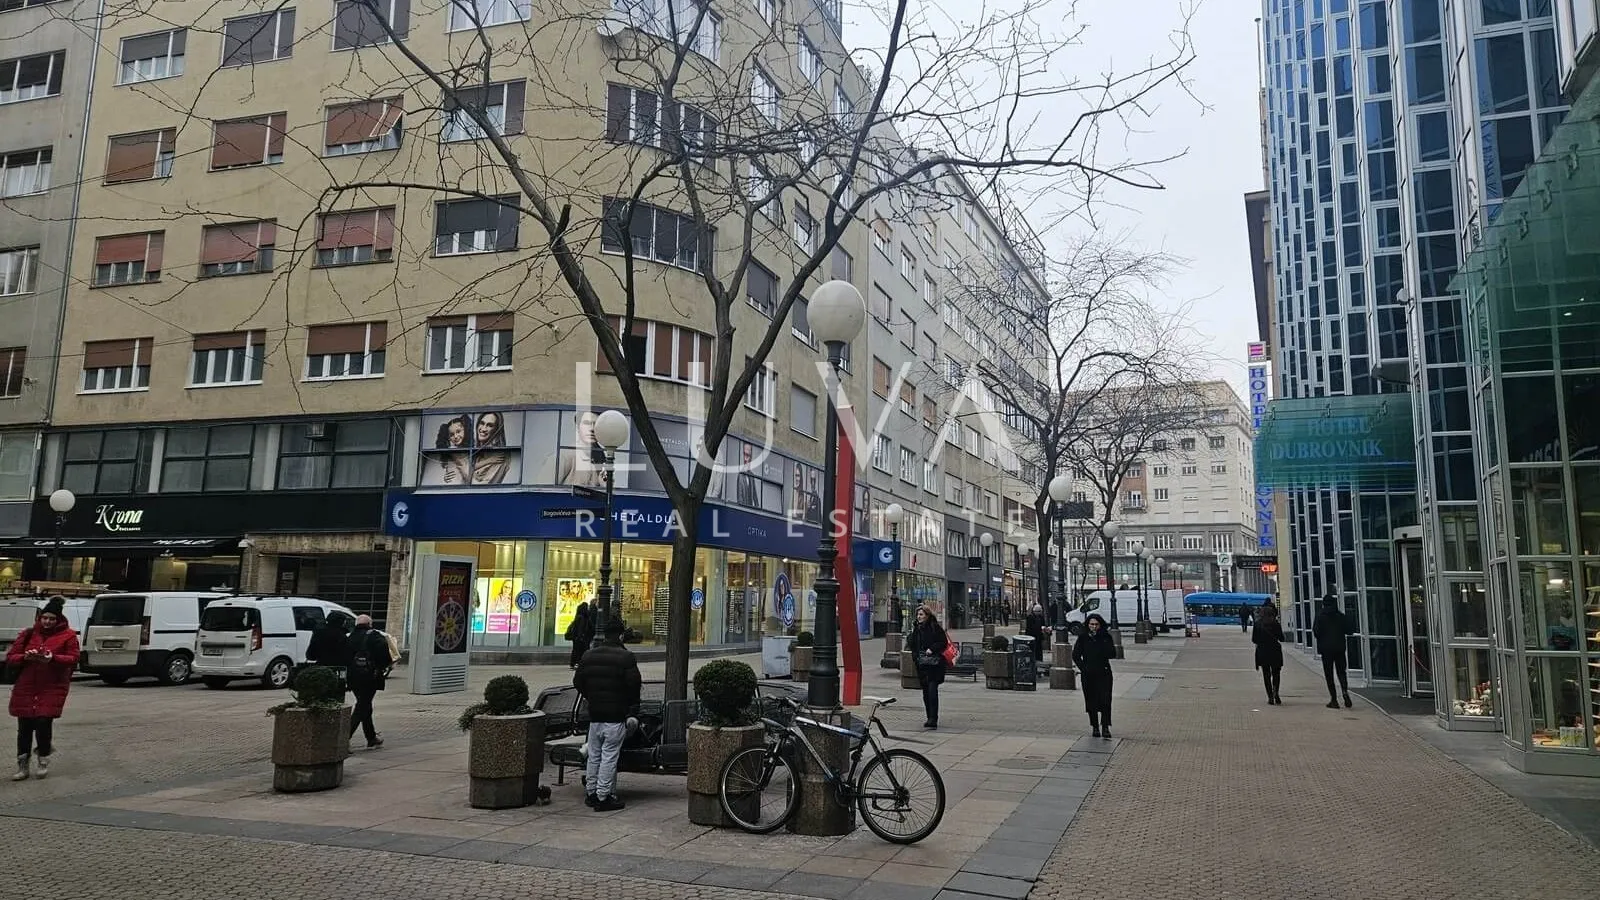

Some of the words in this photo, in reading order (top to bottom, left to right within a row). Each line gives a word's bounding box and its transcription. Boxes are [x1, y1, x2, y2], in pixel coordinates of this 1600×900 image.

[1307, 417, 1373, 436] HOTEL
[1271, 438, 1384, 460] DUBROVNIK
[95, 504, 144, 531] Krona
[600, 511, 677, 525] HETALDU
[747, 526, 767, 537] OPTIKA
[441, 574, 465, 585] RIZK
